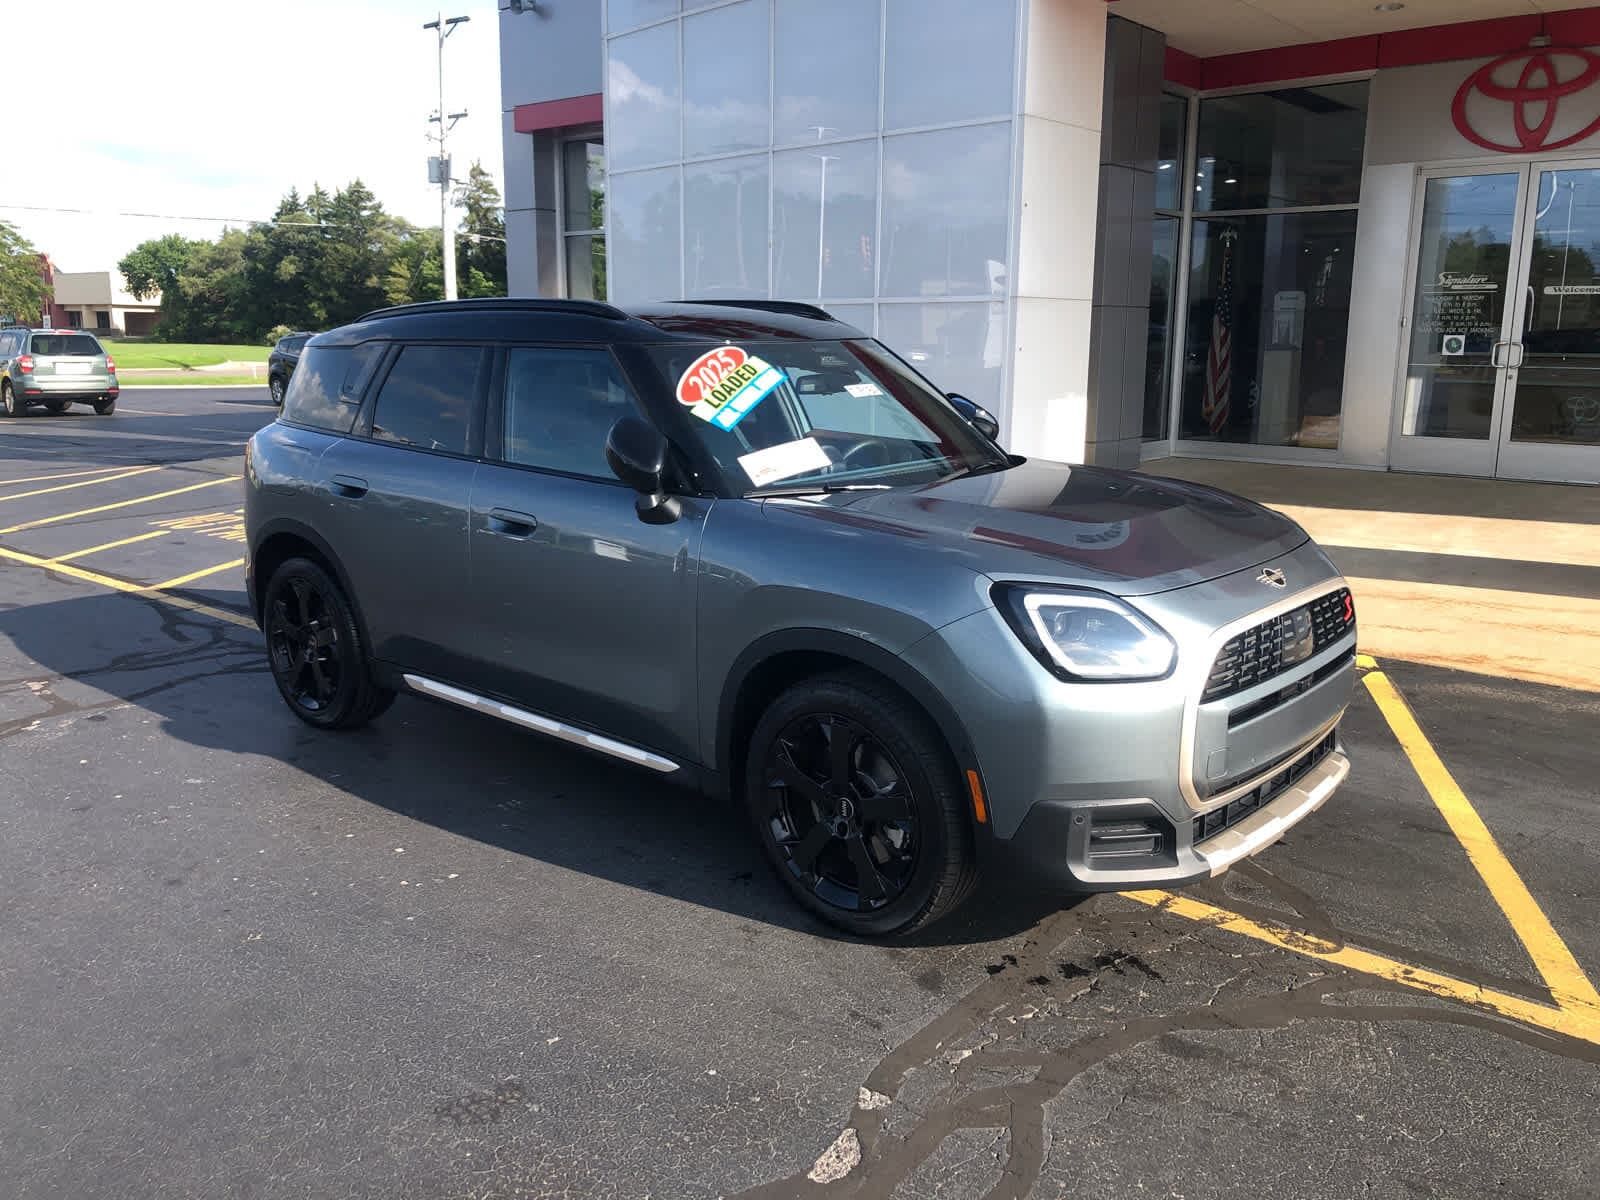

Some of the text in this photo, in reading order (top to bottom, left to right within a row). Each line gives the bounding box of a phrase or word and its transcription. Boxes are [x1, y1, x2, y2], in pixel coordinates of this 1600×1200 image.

[1438, 272, 1489, 289] Signature
[689, 350, 737, 397] 2025
[704, 363, 758, 409] LOADED
